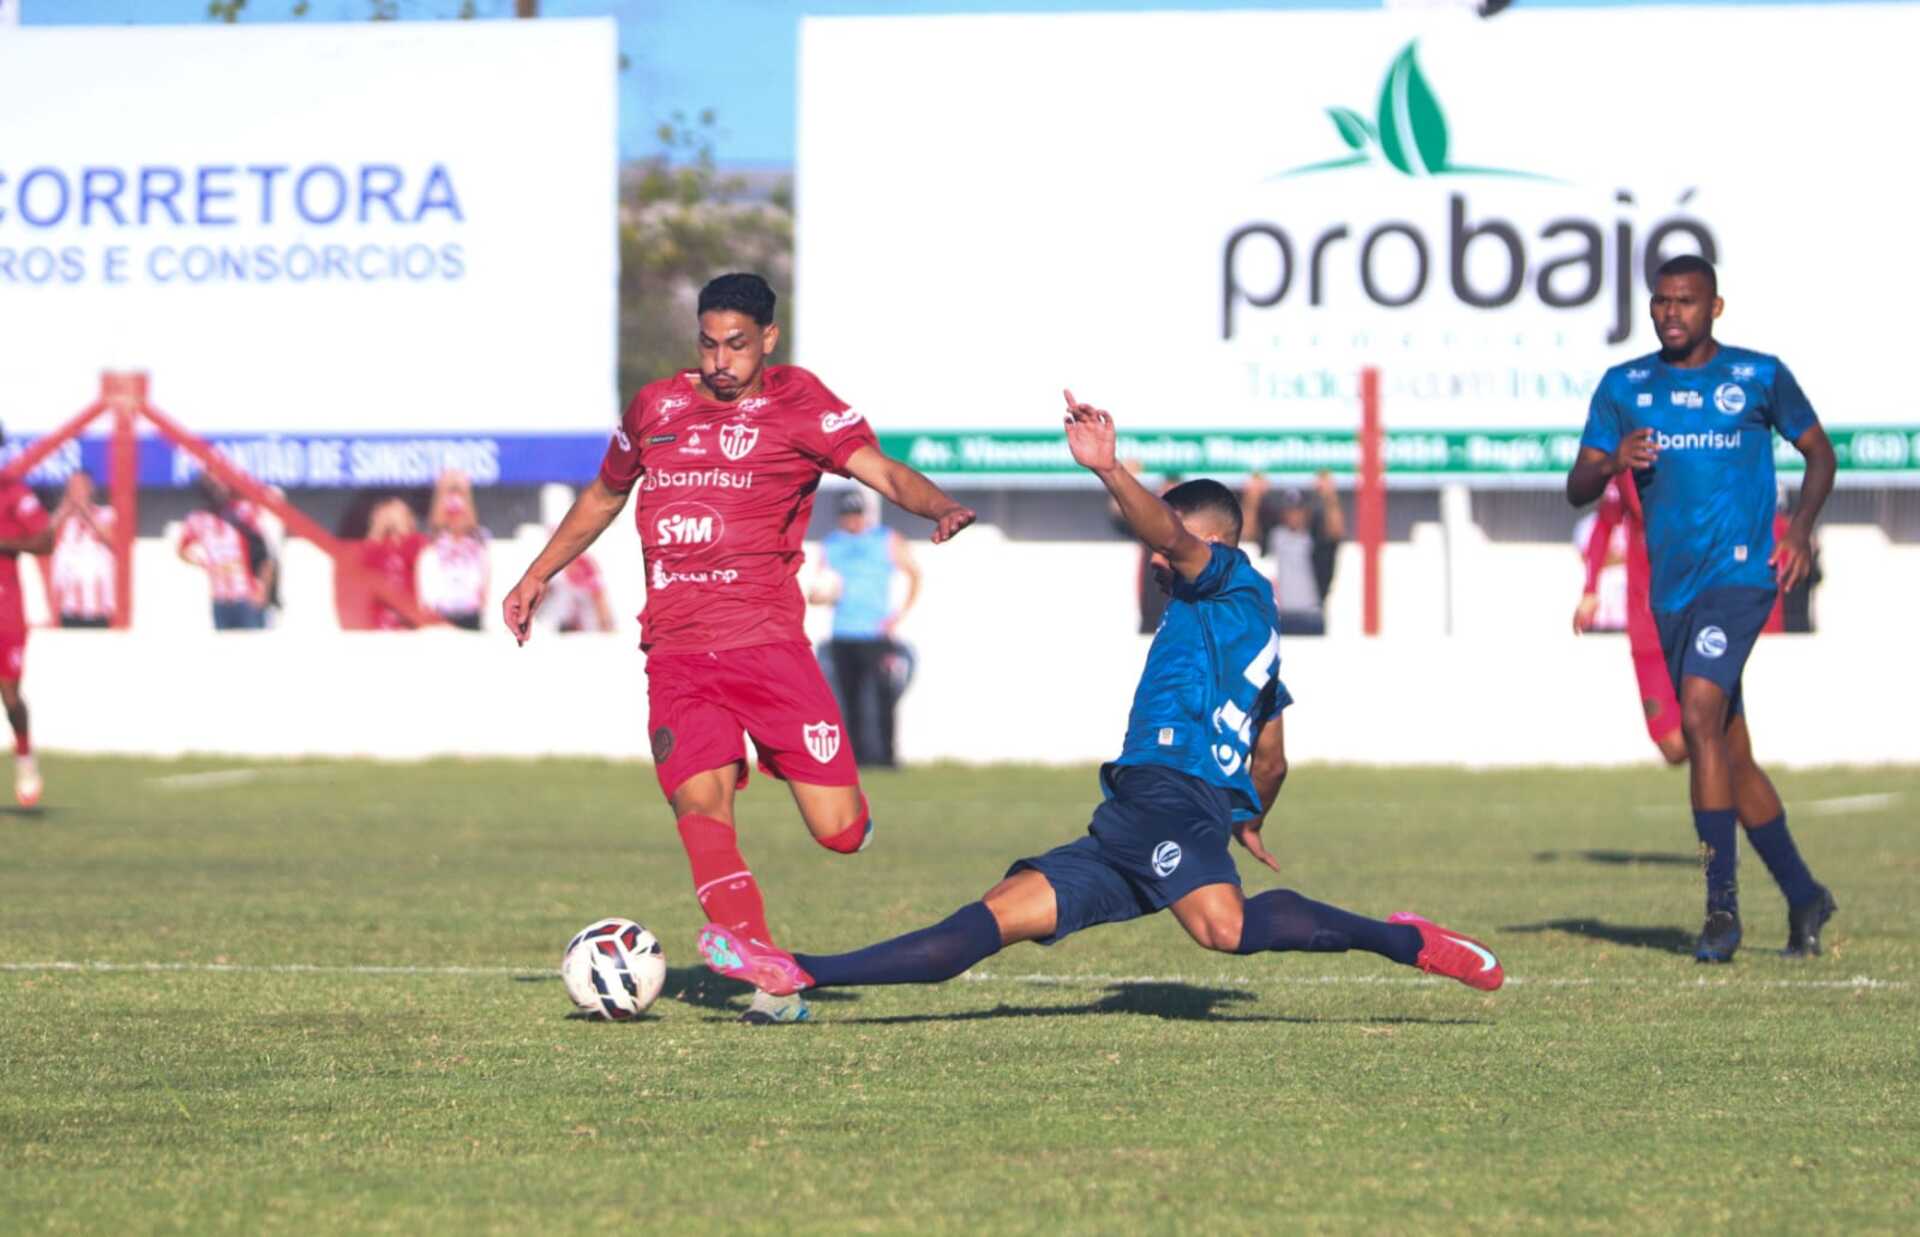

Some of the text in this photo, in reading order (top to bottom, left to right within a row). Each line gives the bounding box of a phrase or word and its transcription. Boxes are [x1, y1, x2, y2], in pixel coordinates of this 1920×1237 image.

[103, 245, 130, 283] E
[1221, 187, 1719, 342] probajé
[1656, 429, 1741, 449] banrisul
[657, 468, 753, 489] banrisul
